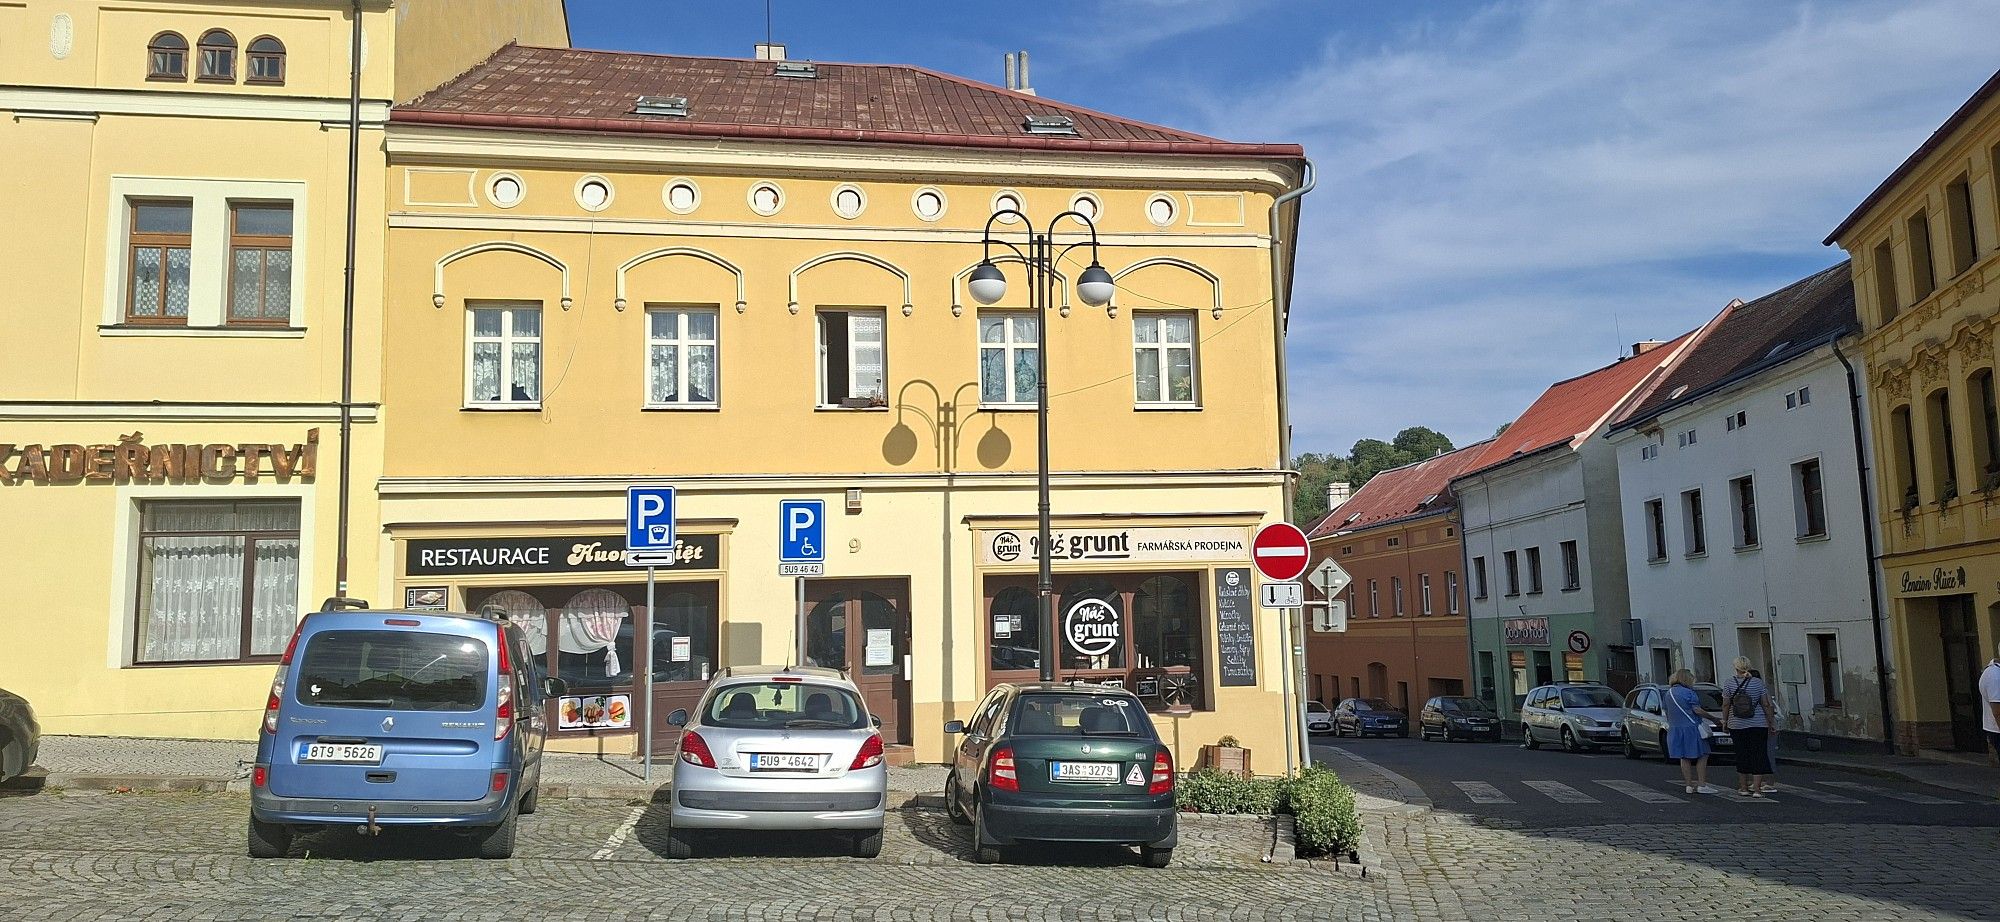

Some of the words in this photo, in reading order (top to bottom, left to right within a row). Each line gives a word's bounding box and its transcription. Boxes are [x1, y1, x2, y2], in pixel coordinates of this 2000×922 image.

[638, 494, 665, 530] P
[789, 507, 815, 542] P
[849, 538, 861, 553] 9
[997, 544, 1021, 554] grunt
[1069, 531, 1130, 559] grunt
[1137, 540, 1193, 551] FARMÁŘSKÁ
[1194, 541, 1243, 552] PRODEJNA
[421, 547, 550, 567] RESTAURACE
[784, 565, 798, 573] 5U9
[810, 565, 819, 573] 42
[1079, 606, 1105, 622] Náš
[1074, 621, 1119, 642] grunt
[311, 746, 334, 758] 8T9
[344, 746, 375, 759] 5626
[760, 755, 780, 766] 5U9
[788, 756, 814, 767] 4642
[1062, 764, 1081, 776] 3AS
[1088, 765, 1113, 776] 3279
